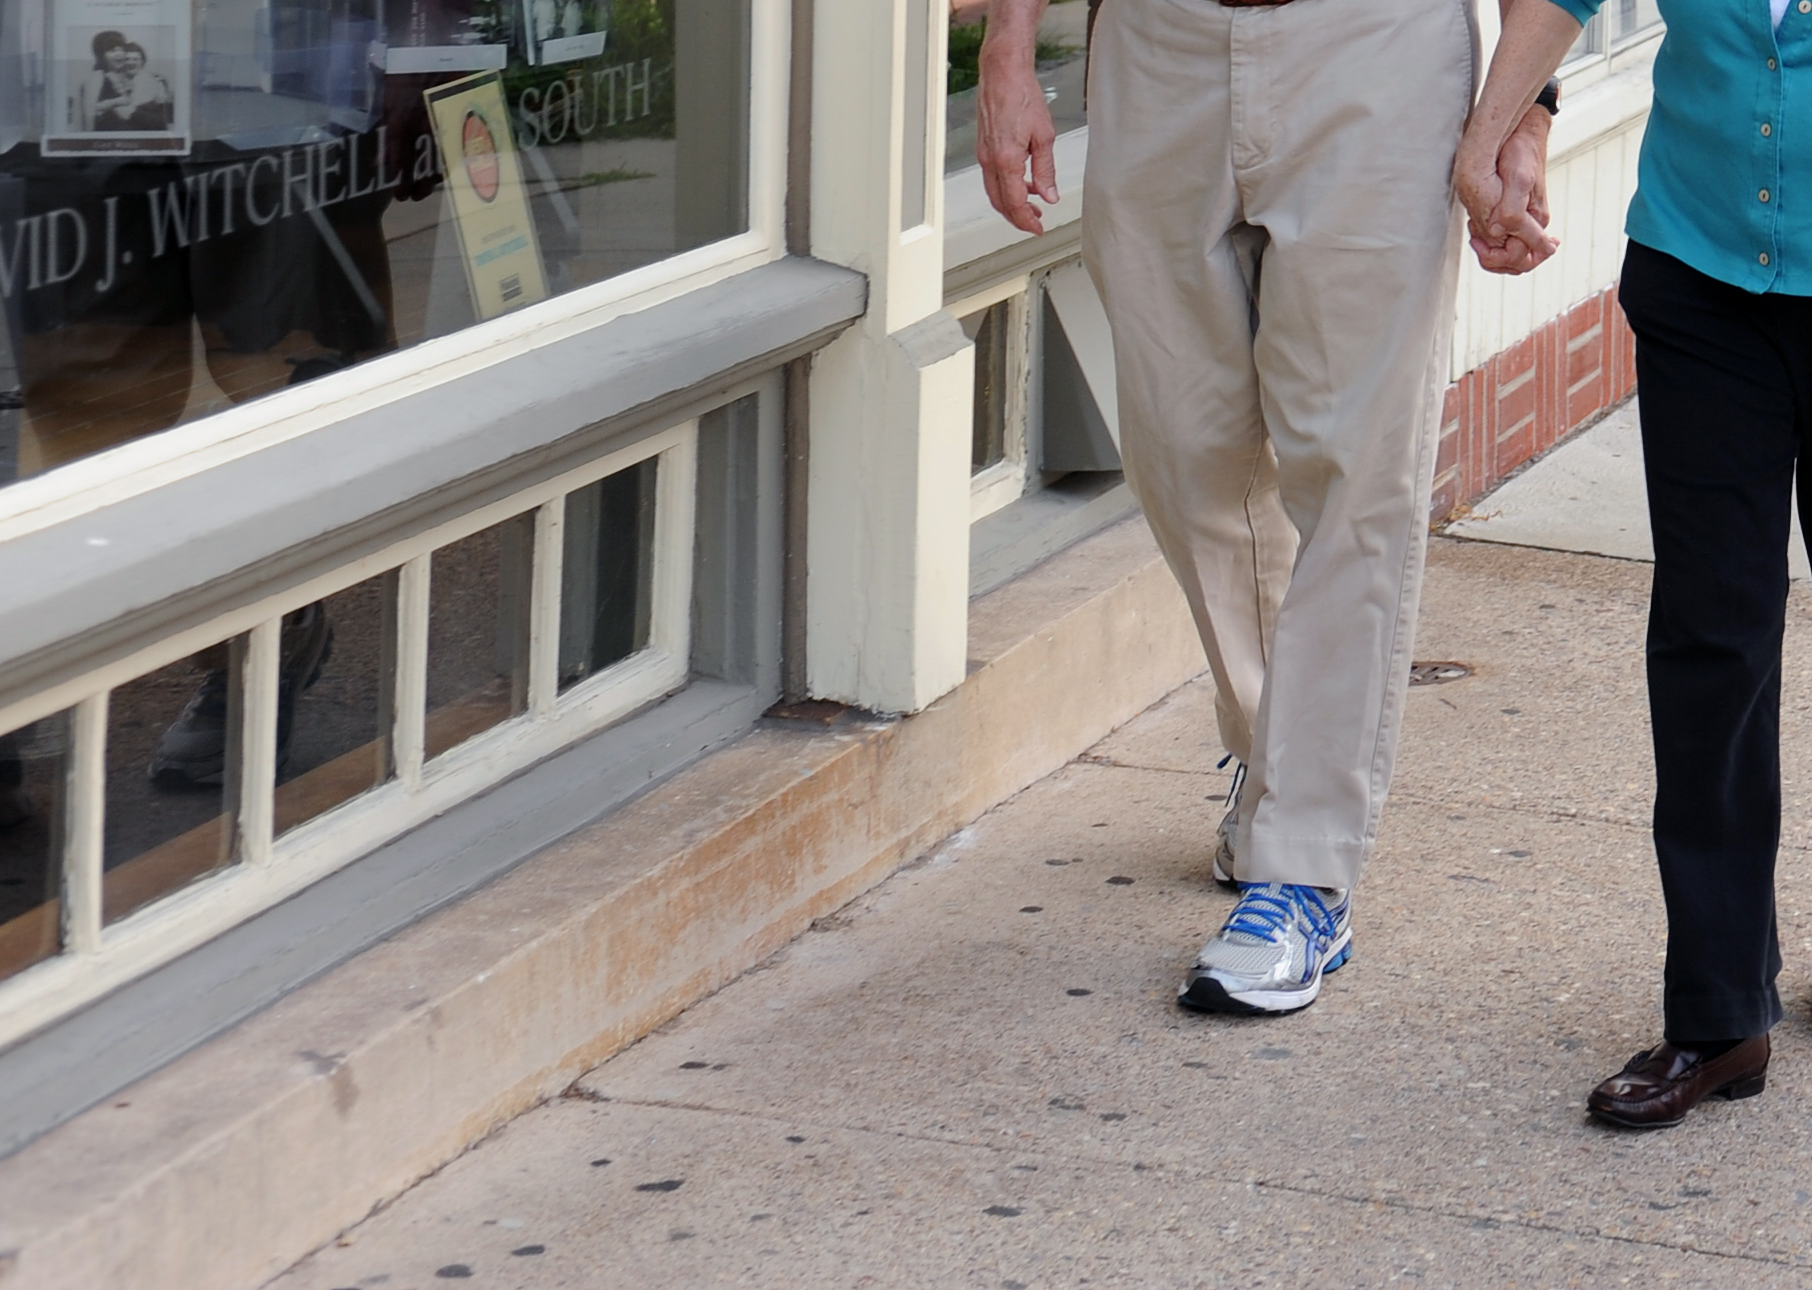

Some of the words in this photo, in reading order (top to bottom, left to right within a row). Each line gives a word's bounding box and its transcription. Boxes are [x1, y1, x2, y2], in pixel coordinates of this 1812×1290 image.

[95, 196, 133, 293] J.
[147, 124, 402, 259] WITCHELL
[518, 57, 652, 151] SOUTH
